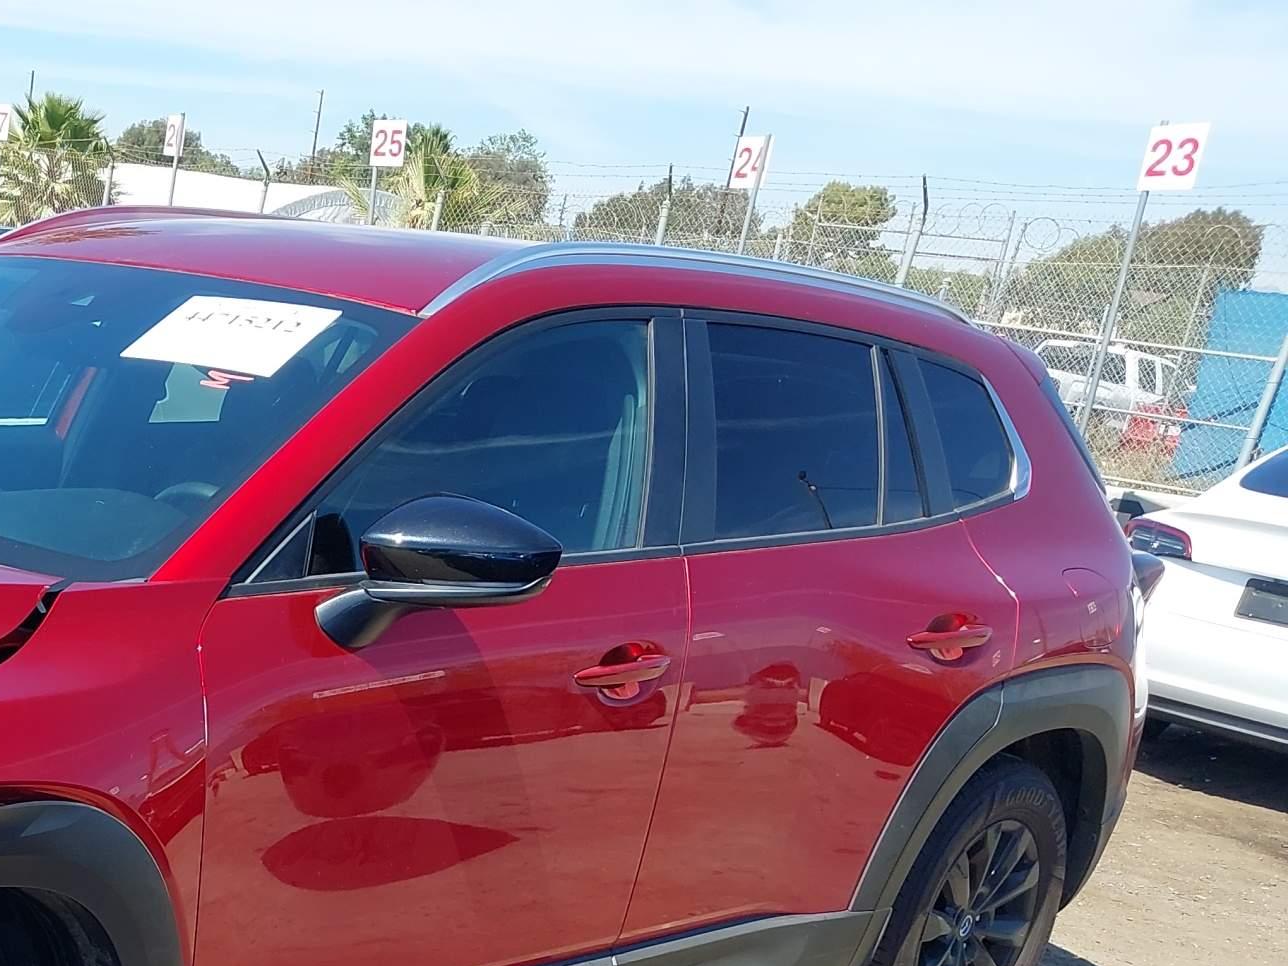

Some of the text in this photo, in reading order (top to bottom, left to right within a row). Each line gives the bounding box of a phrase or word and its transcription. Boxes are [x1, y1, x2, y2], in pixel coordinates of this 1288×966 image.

[166, 123, 180, 148] 2
[373, 129, 404, 157] 25
[1143, 137, 1200, 177] 23
